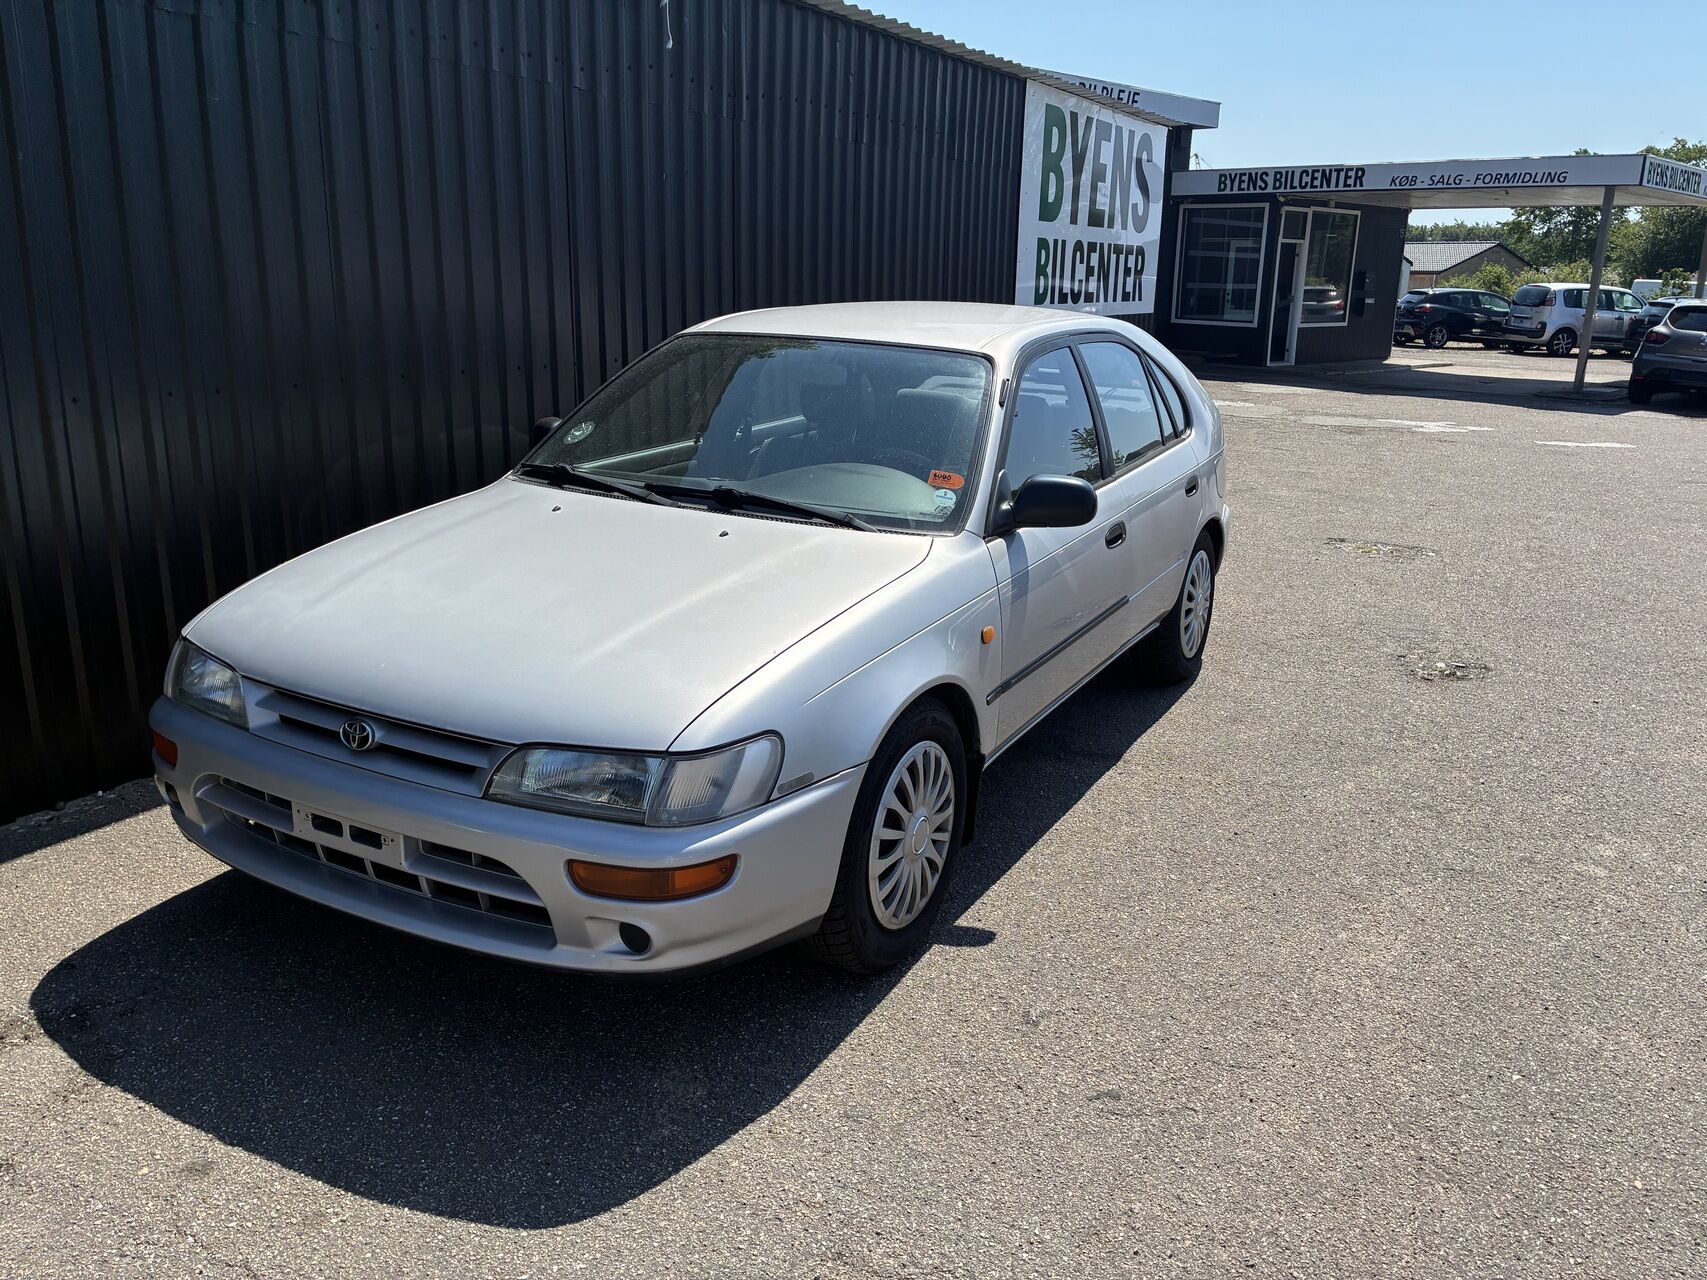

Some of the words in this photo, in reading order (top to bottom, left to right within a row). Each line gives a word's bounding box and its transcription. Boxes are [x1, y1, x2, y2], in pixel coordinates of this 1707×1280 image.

[1039, 103, 1153, 233] BYENS
[1217, 171, 1269, 192] BYENS
[1272, 167, 1366, 190] BILCENTER
[1389, 175, 1418, 187] KØB
[1428, 173, 1464, 186] SALG
[1473, 171, 1569, 185] FORMIDLING
[1646, 160, 1669, 188] BYENS
[1034, 237, 1145, 306] BILCENTER
